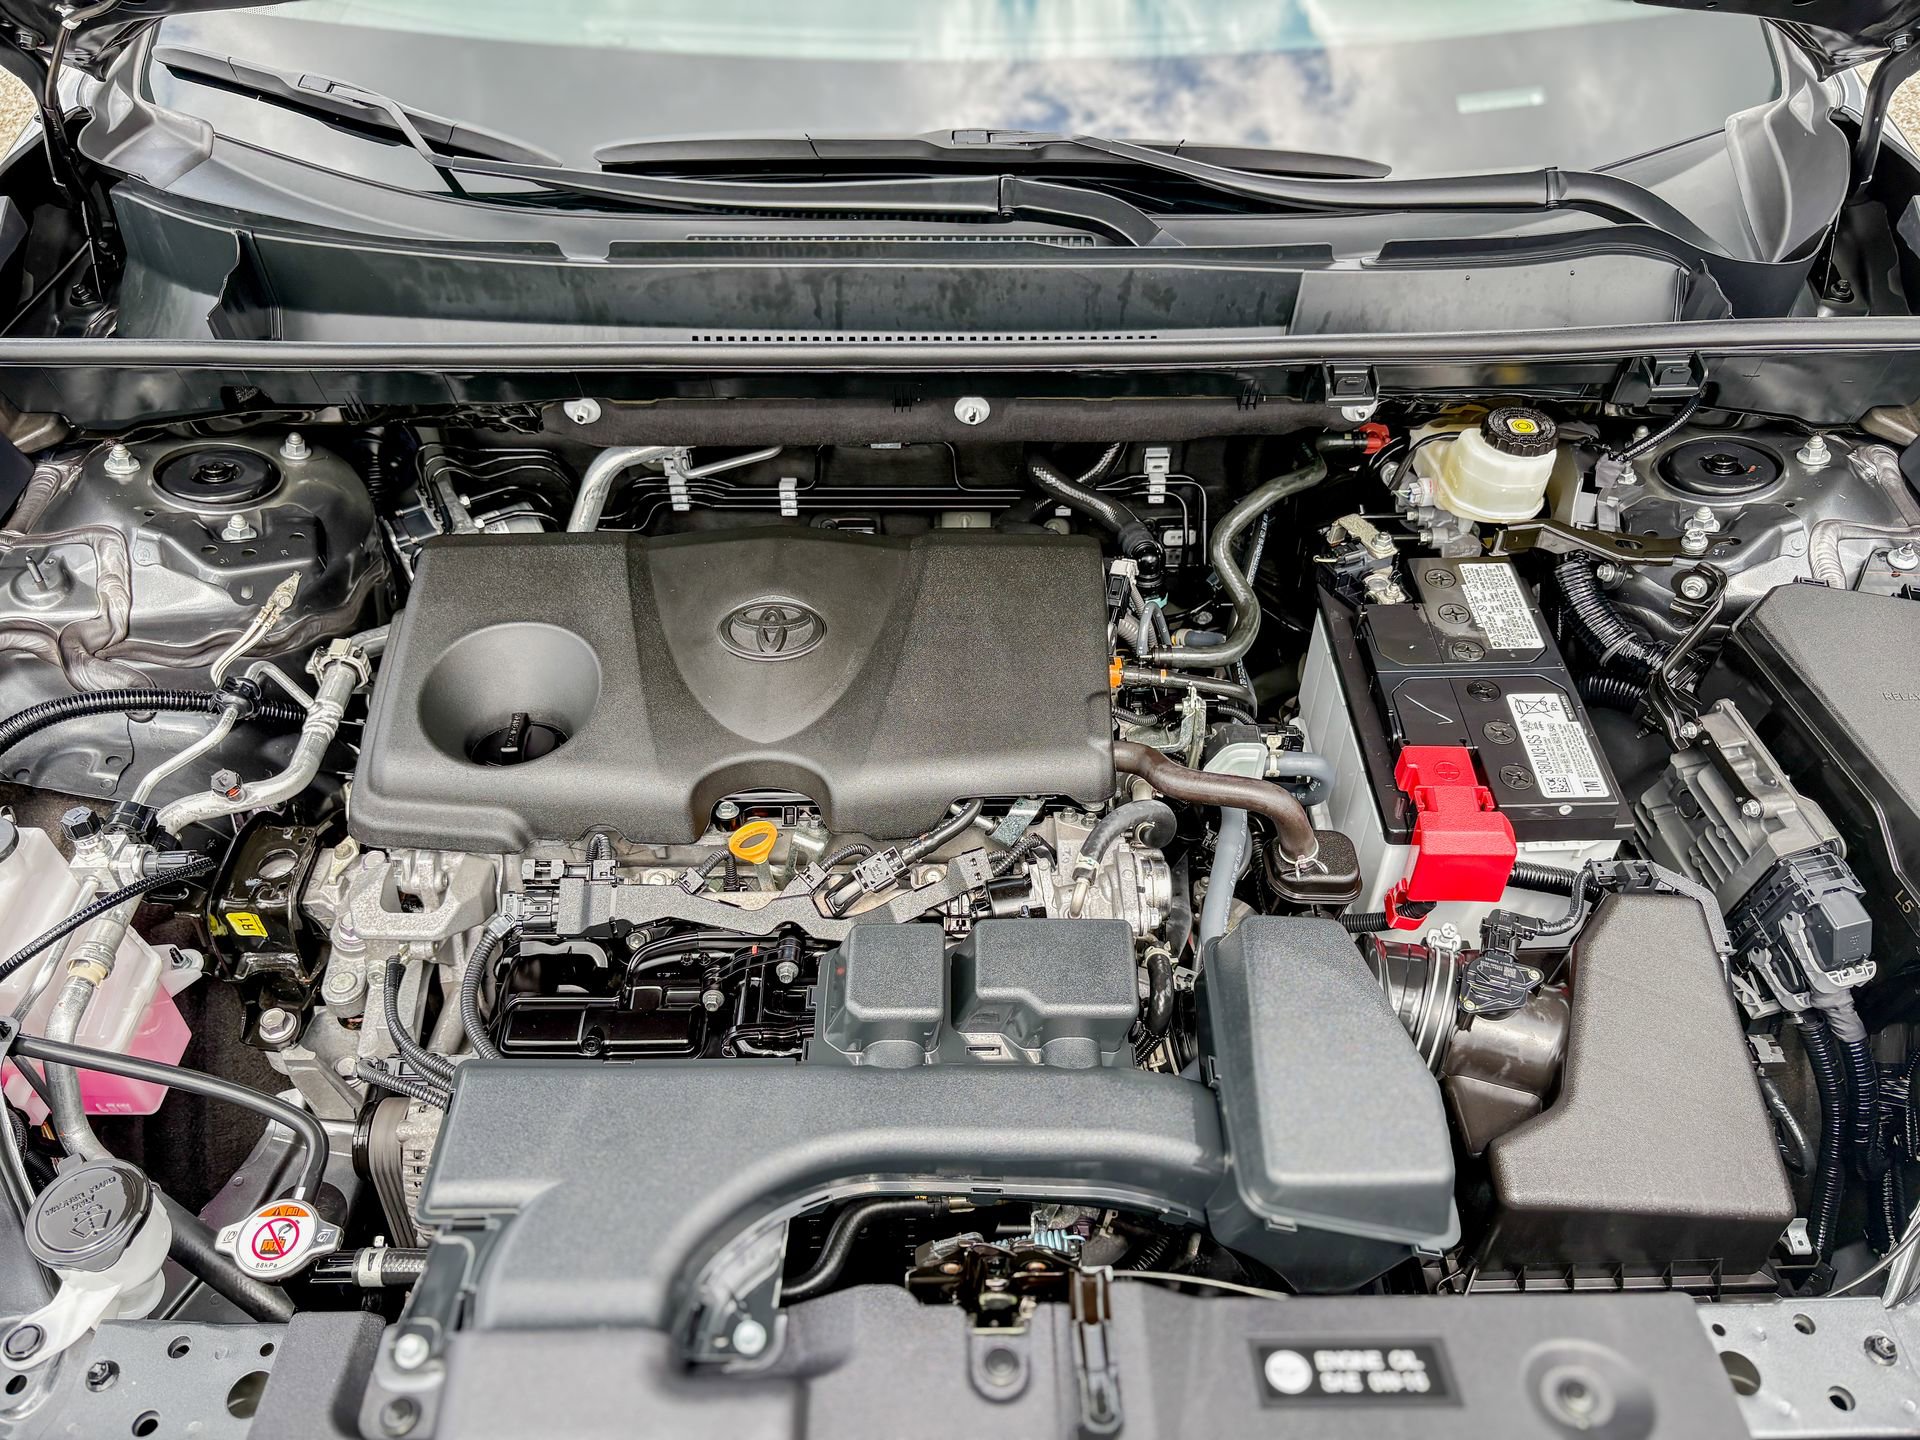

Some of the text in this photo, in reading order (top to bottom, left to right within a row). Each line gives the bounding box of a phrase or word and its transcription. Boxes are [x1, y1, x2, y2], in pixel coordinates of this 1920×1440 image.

[1550, 701, 1561, 712] Pb
[1583, 781, 1601, 793] TM
[1894, 889, 1915, 914] L5
[238, 918, 256, 931] R1
[45, 1176, 117, 1216] WASHER FLUID
[71, 1194, 95, 1211] ONLY
[1313, 1349, 1426, 1371] ENGINE OIL
[1319, 1371, 1364, 1393] SAE
